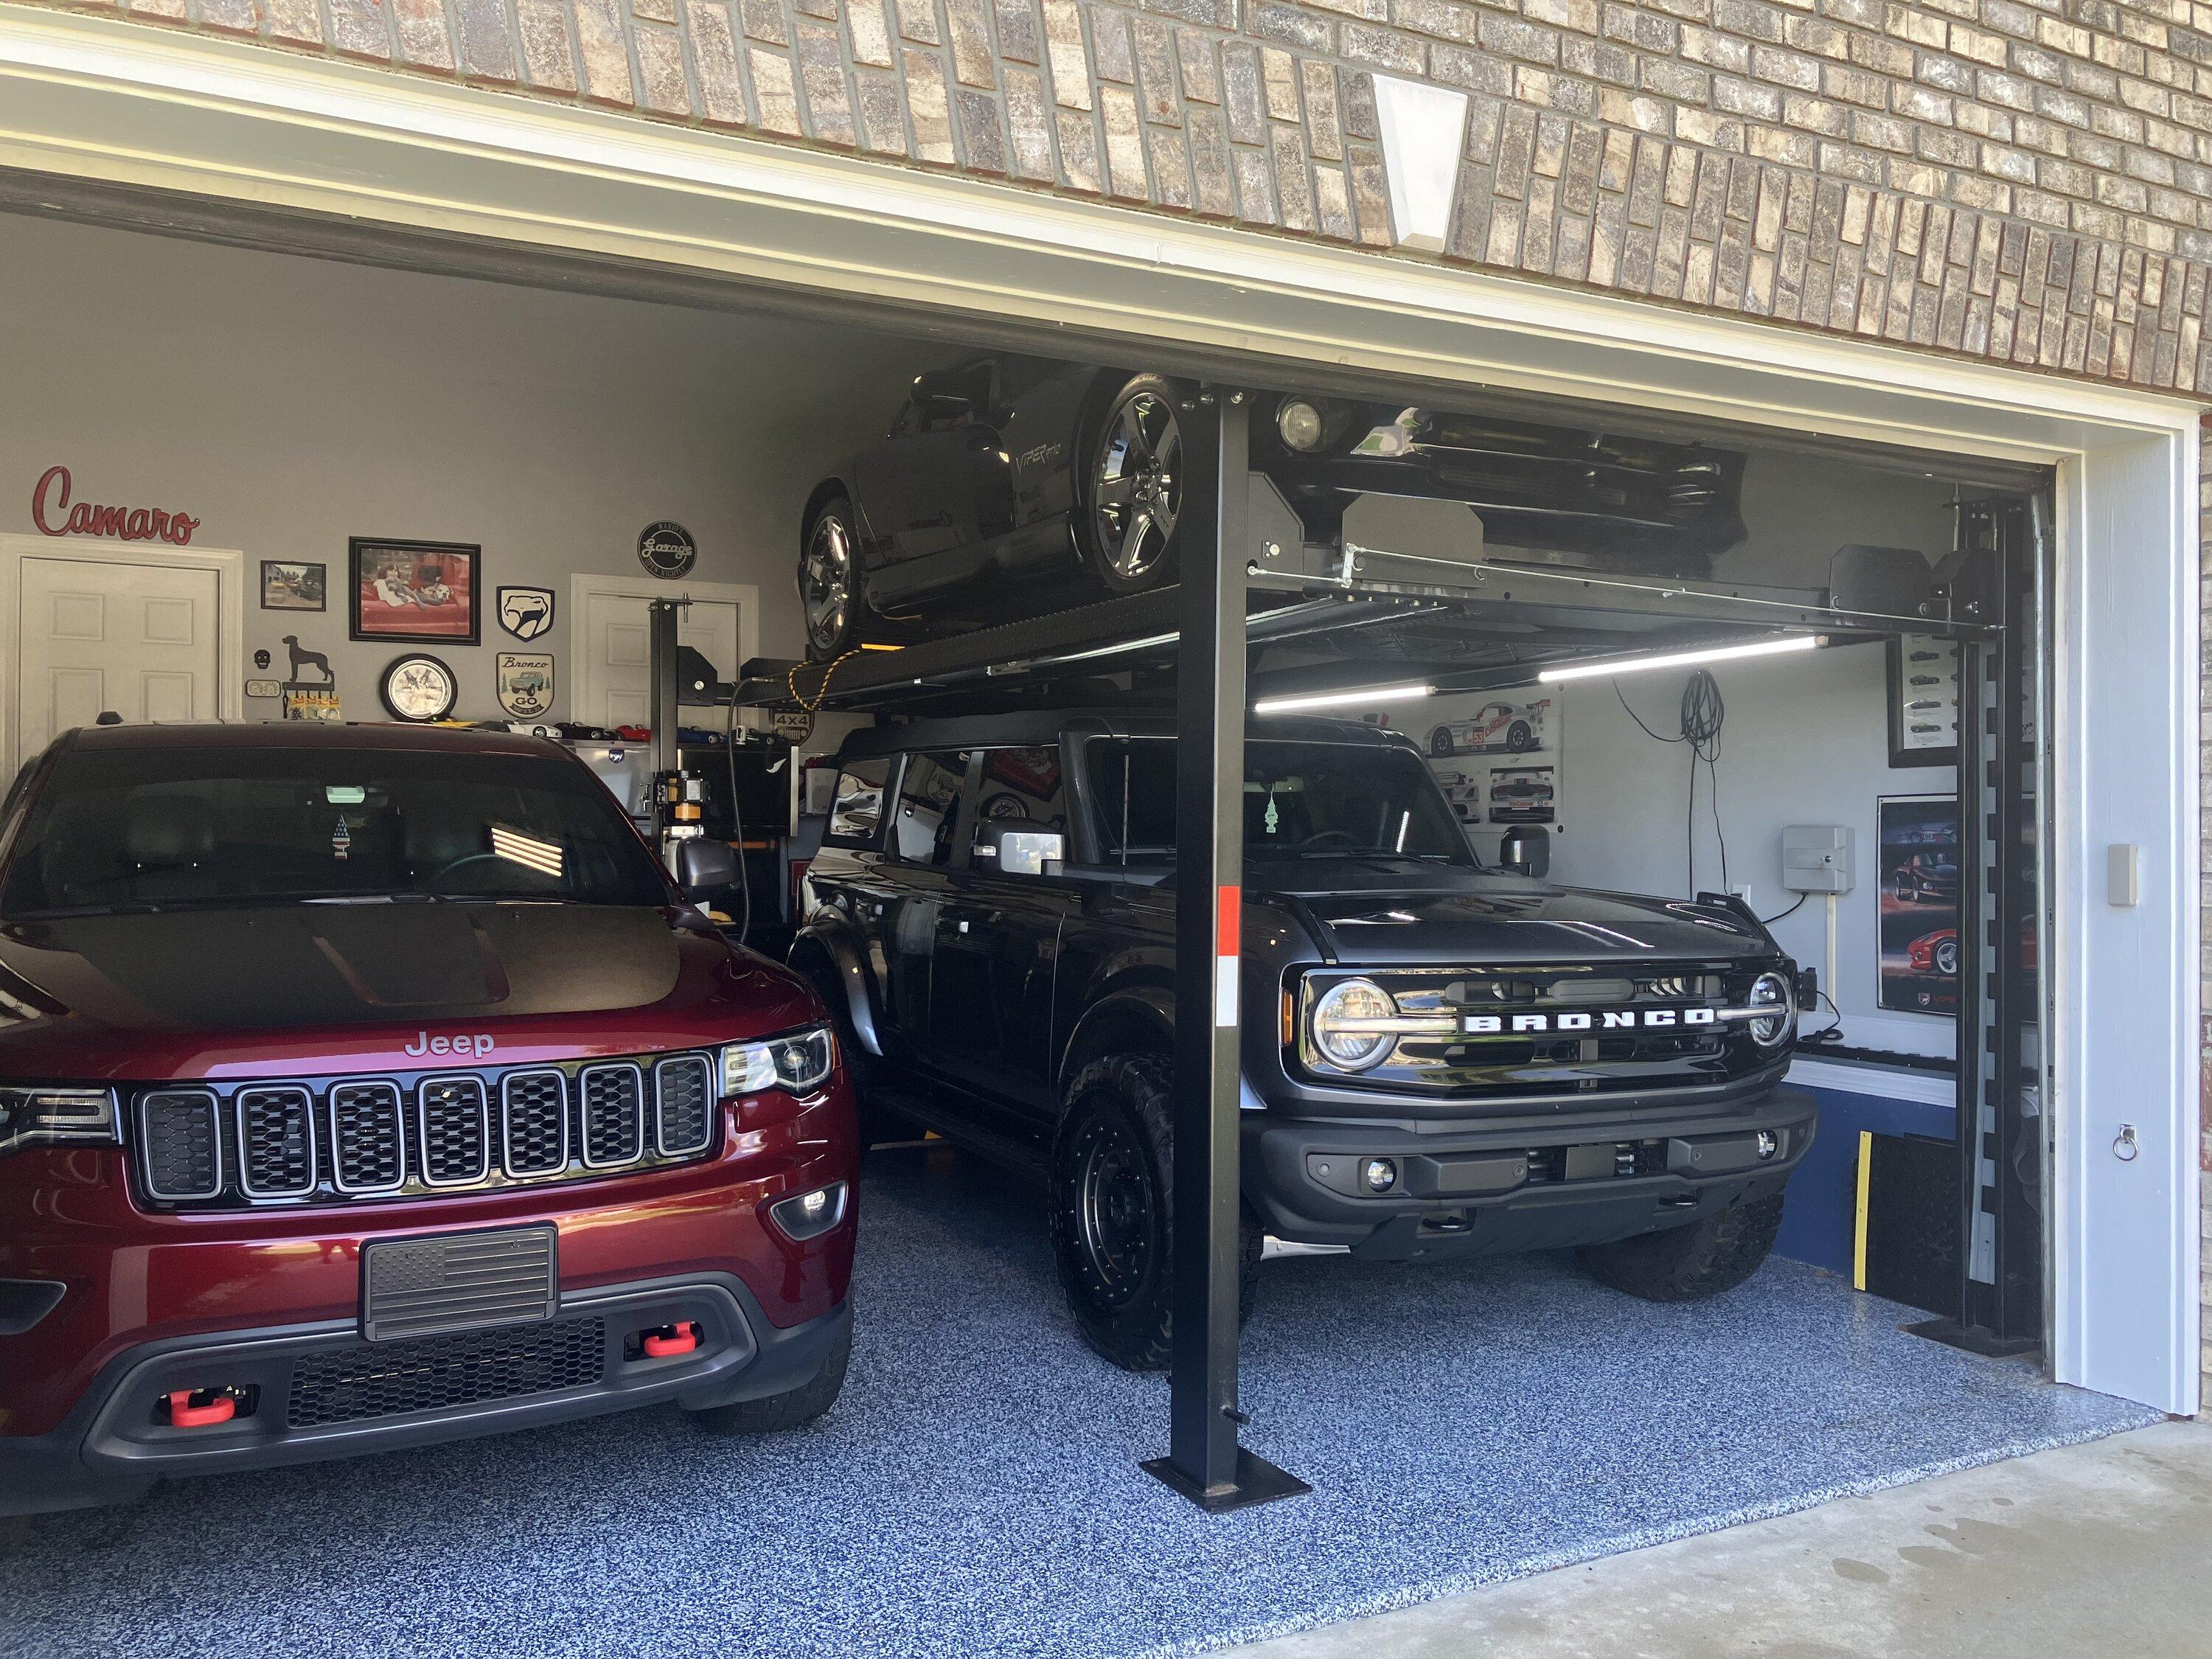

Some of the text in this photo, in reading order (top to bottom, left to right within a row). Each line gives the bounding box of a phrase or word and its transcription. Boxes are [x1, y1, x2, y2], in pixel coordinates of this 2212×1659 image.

[1015, 443, 1046, 474] VIPER
[32, 466, 200, 546] Camaro
[641, 538, 693, 560] Garage
[644, 558, 686, 577] OPEN NIGHTLY
[501, 656, 549, 668] Bronco
[515, 697, 538, 705] GO
[1465, 1008, 1714, 1032] BRONCO
[405, 1031, 495, 1059] Jeep
